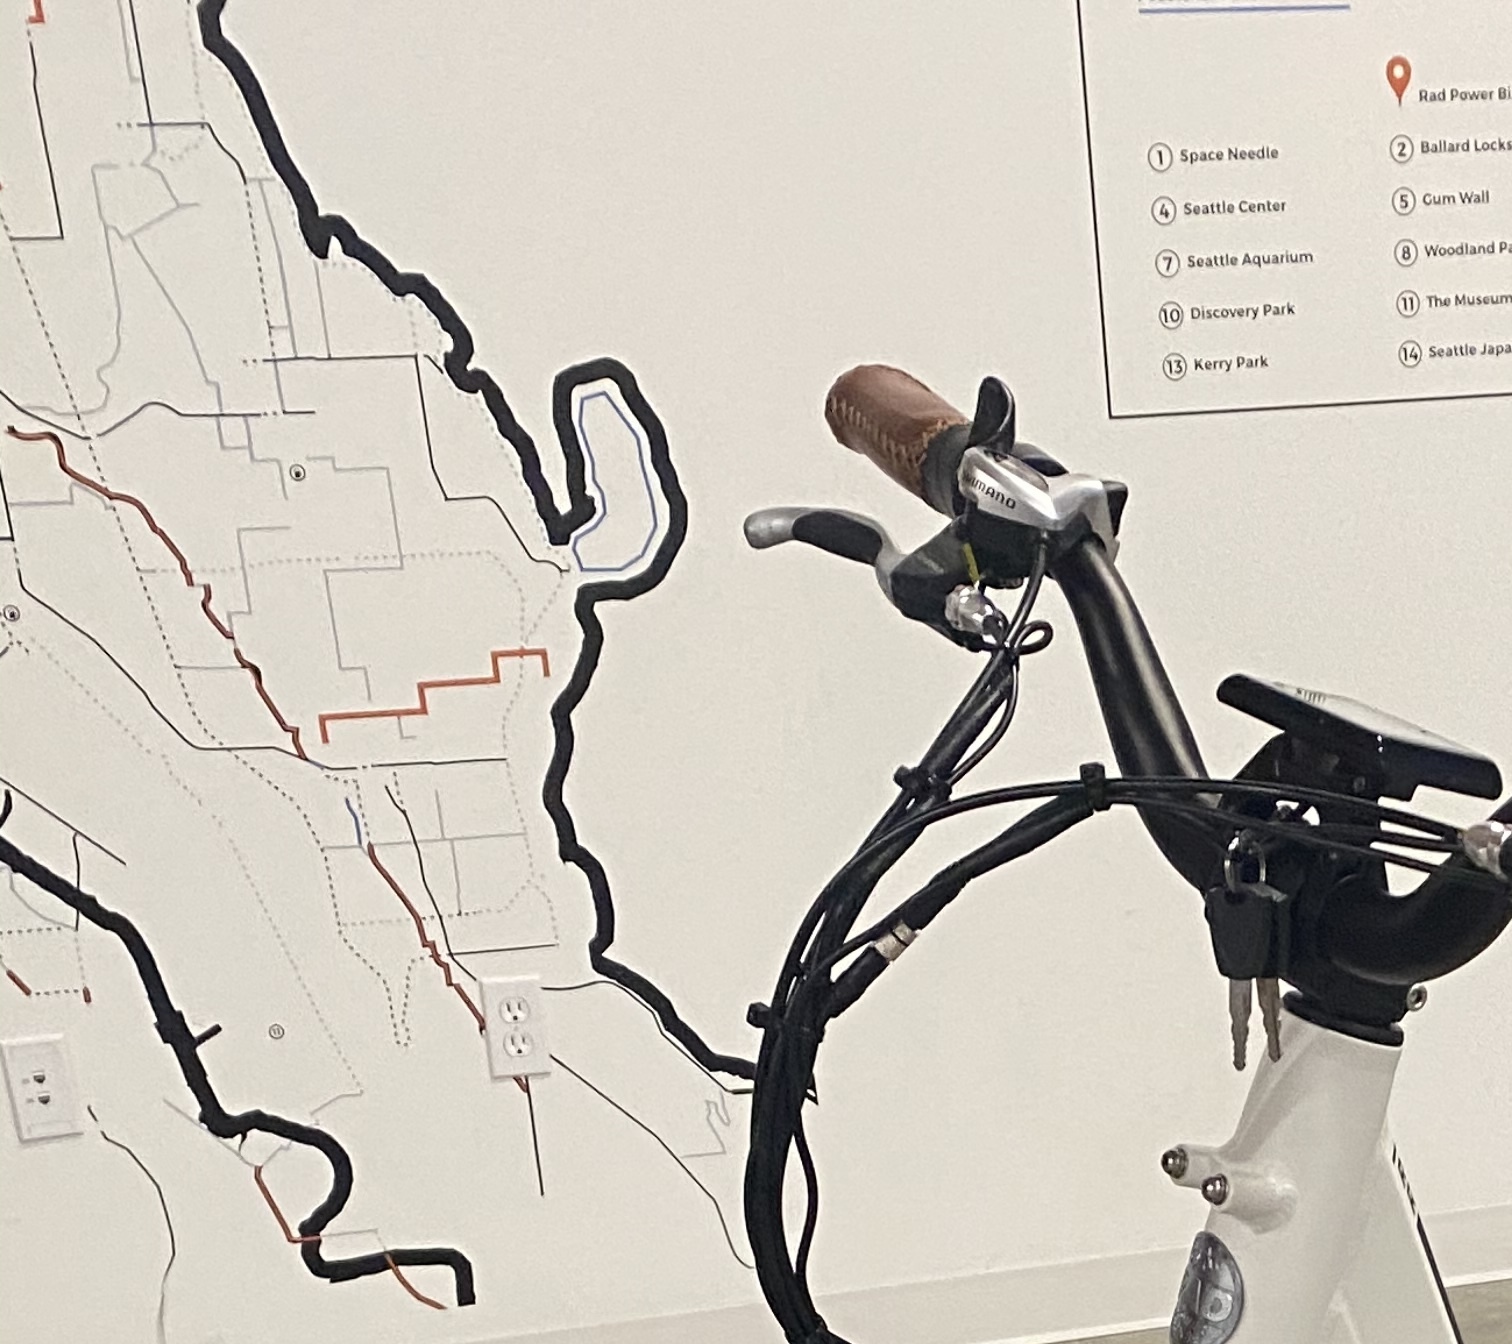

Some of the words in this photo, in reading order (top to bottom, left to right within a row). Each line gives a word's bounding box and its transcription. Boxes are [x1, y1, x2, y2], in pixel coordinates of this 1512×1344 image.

[1418, 88, 1446, 102] Rad
[1450, 88, 1494, 101] Power
[1420, 139, 1470, 154] Ballard
[1474, 137, 1512, 151] Locks
[1180, 149, 1224, 164] Space
[1227, 146, 1279, 160] Needle
[1422, 193, 1456, 206] Gum
[1459, 190, 1489, 204] Wall
[1184, 200, 1235, 215] Seattle
[1239, 200, 1286, 213] Center
[1424, 241, 1495, 257] Woodland
[1187, 253, 1238, 268] Seattle
[1242, 250, 1314, 268] Aquarium
[1426, 294, 1450, 308] The
[1454, 292, 1512, 306] Museum
[1191, 306, 1259, 320] Discovery
[1263, 302, 1295, 316] Park
[1428, 343, 1476, 358] Seattle
[1194, 358, 1232, 372] Kerry
[1236, 355, 1268, 369] Park
[963, 473, 1016, 509] IMANO
